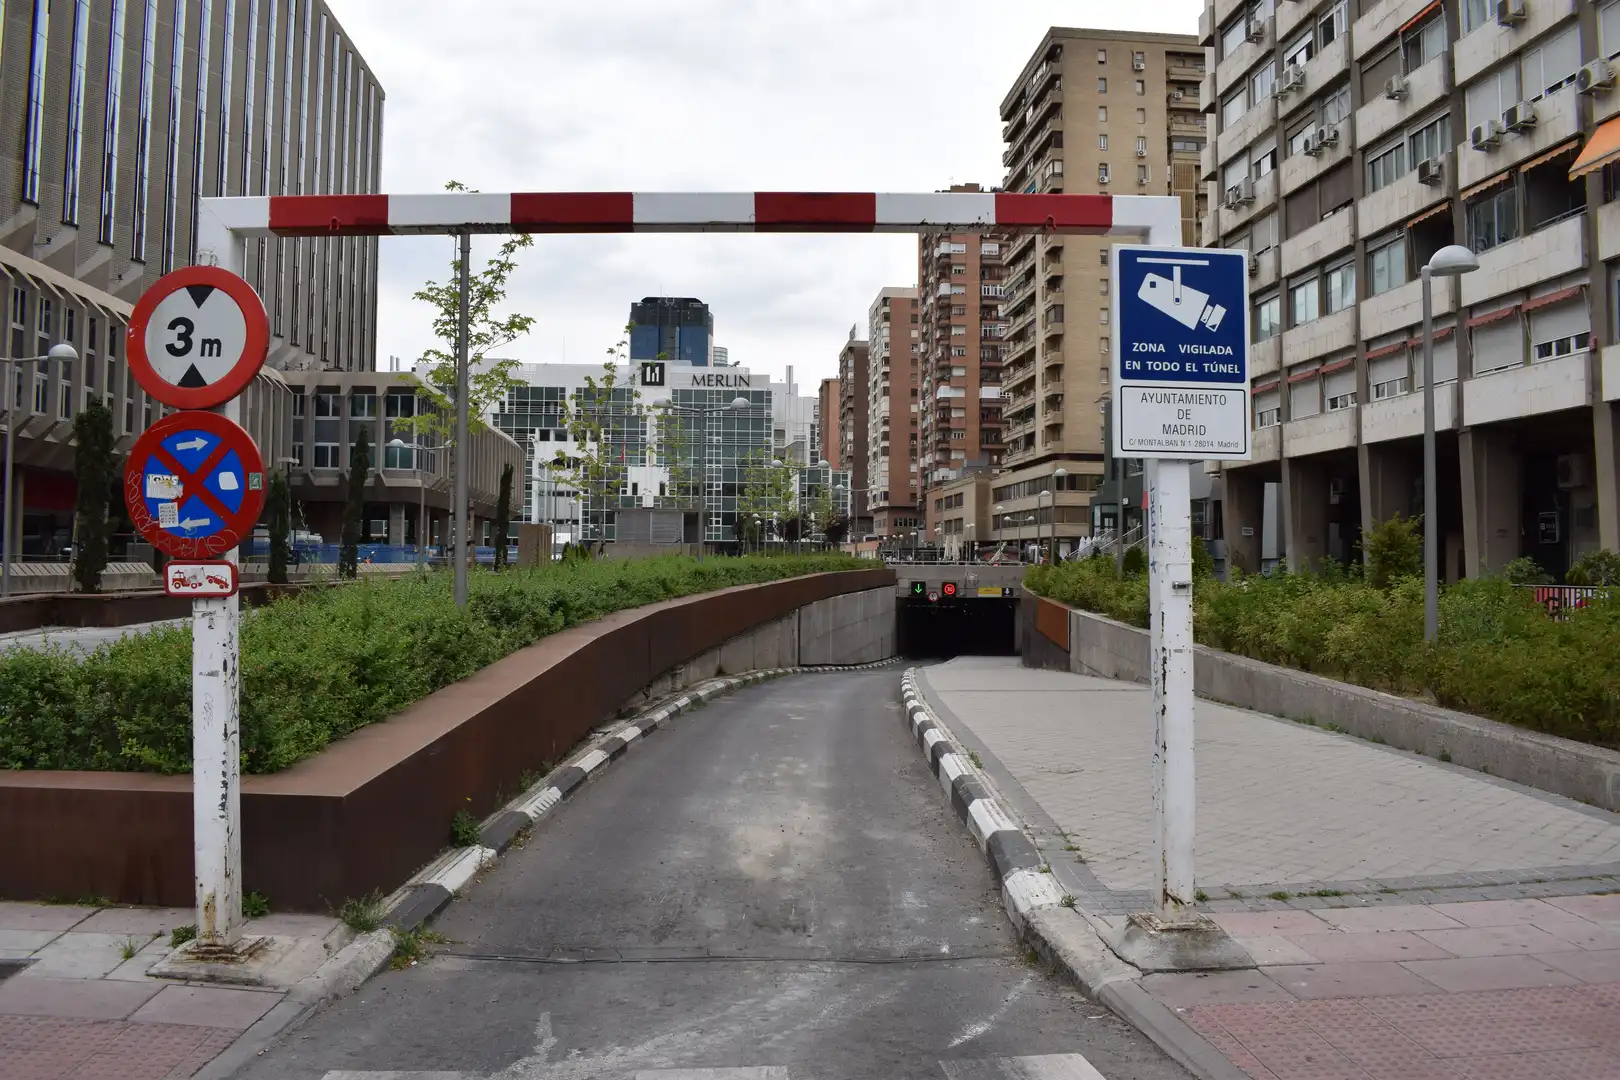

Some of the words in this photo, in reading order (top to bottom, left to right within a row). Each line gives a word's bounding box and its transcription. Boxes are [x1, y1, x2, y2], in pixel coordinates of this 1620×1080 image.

[165, 316, 194, 358] 3
[200, 337, 222, 358] m
[1132, 342, 1166, 353] ZONA
[1178, 344, 1233, 356] VIGILADA
[1125, 361, 1141, 371] EN
[1146, 361, 1180, 372] TODO
[1185, 362, 1198, 372] EL
[1203, 361, 1241, 374] TÚNEL
[691, 374, 750, 387] MERLIN
[1140, 392, 1227, 406] AYUNTAMIENTO
[1177, 409, 1192, 420] DE
[1162, 424, 1207, 436] MADRID
[1129, 438, 1136, 446] C/
[1217, 440, 1239, 448] Madrid
